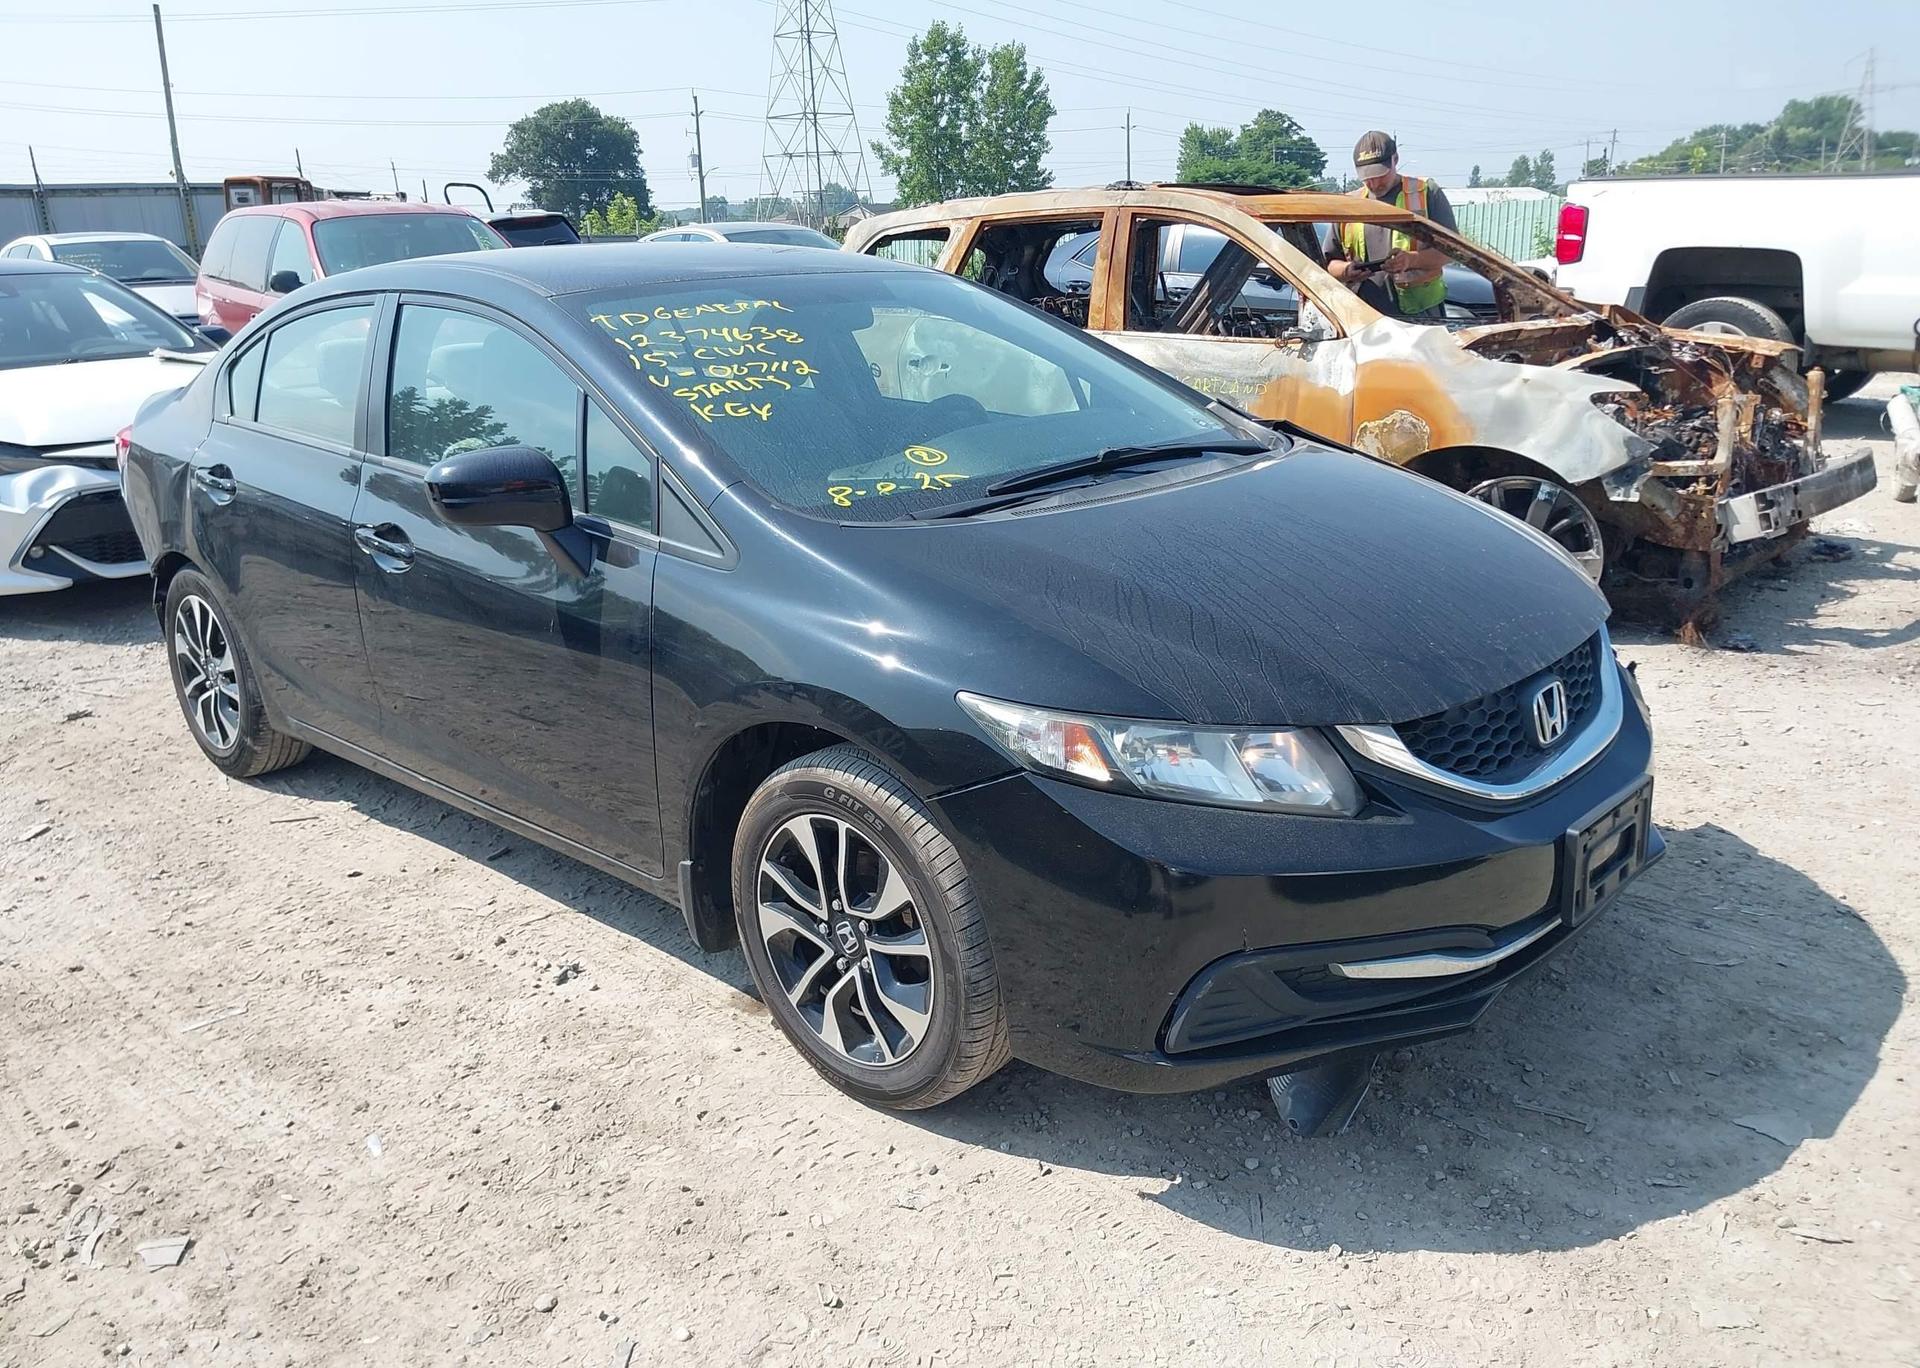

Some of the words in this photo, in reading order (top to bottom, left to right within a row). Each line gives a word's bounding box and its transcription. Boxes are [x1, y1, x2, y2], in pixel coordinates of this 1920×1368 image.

[693, 342, 778, 360] CIVIC
[1175, 375, 1268, 396] ARTLAND
[690, 402, 774, 423] KEY
[838, 793, 863, 811] FIT
